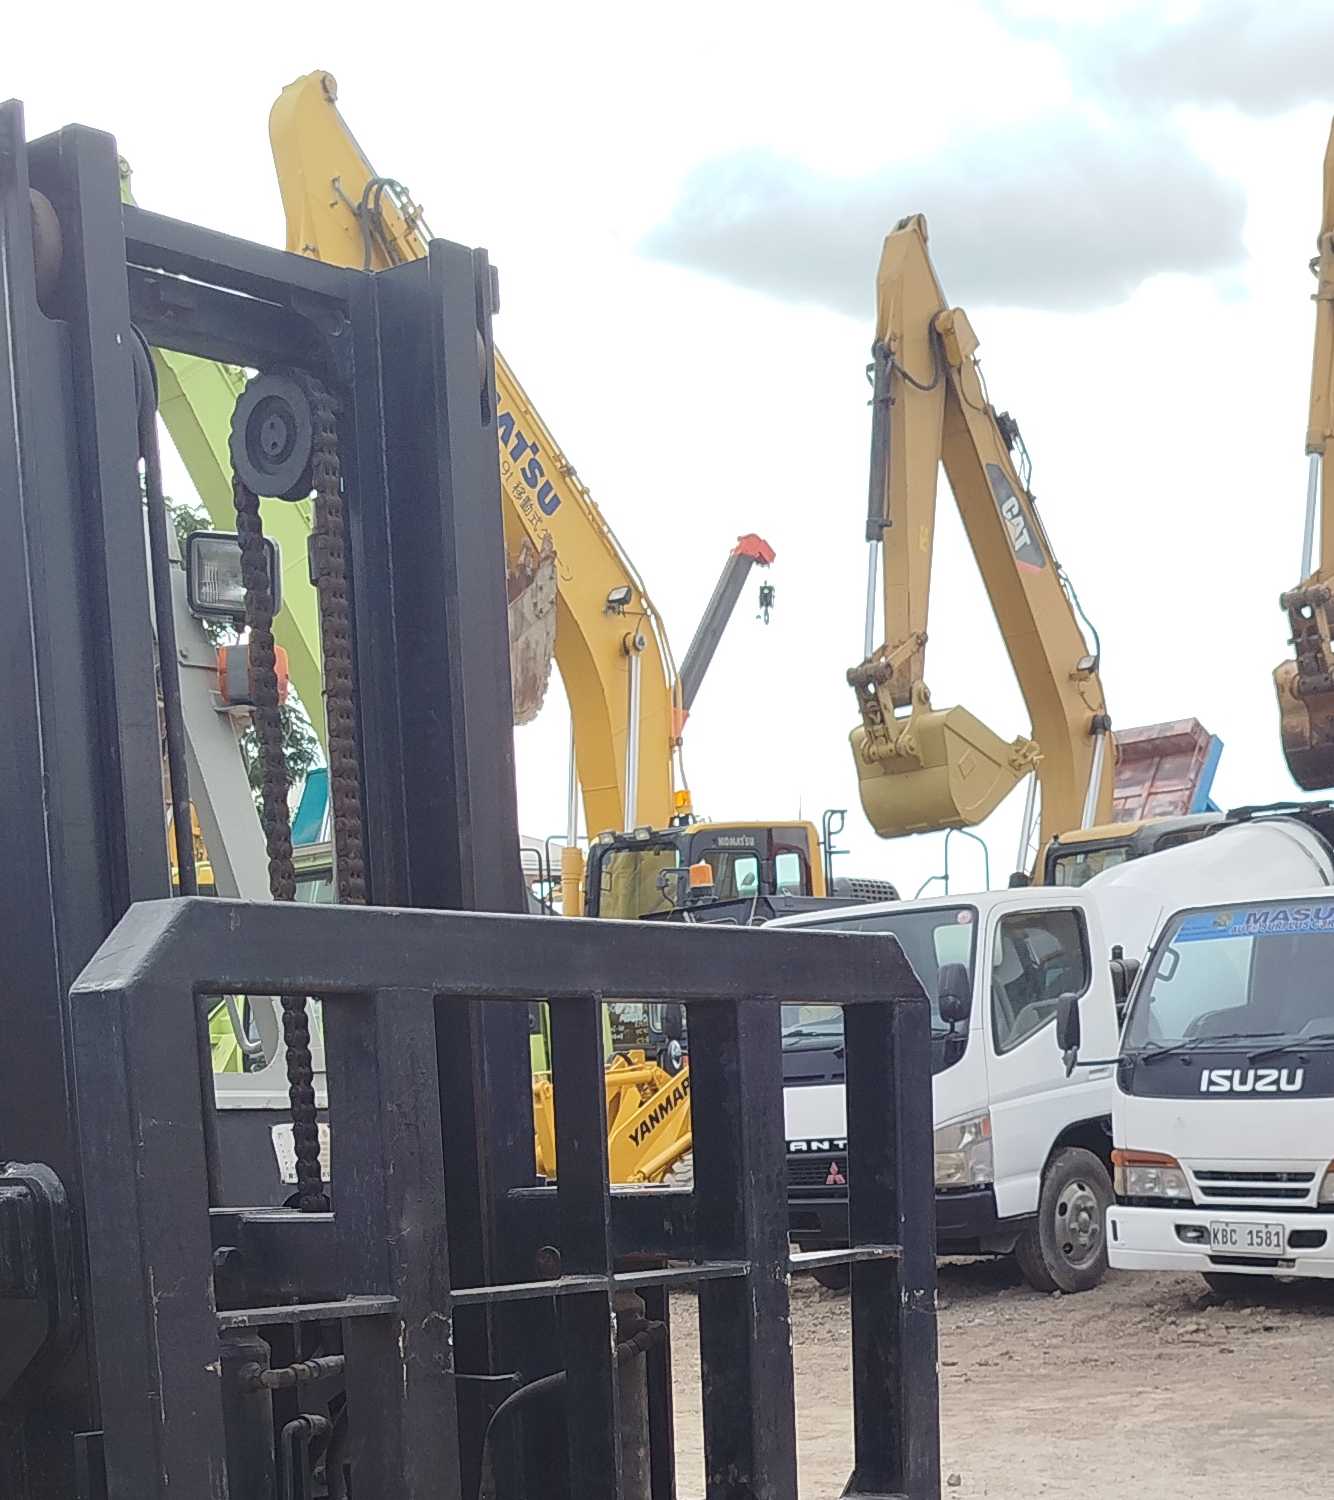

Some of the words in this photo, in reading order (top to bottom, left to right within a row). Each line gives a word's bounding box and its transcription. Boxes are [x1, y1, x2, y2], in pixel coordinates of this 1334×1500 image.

[496, 392, 562, 517] ATSU
[1001, 496, 1031, 552] CAT
[717, 834, 755, 847] KOMATSU
[1230, 924, 1257, 935] AUTO
[1258, 919, 1309, 932] SURPLUS
[1199, 1068, 1305, 1092] ISUZU
[1212, 1227, 1238, 1246] KBC
[1246, 1229, 1281, 1248] 1581
